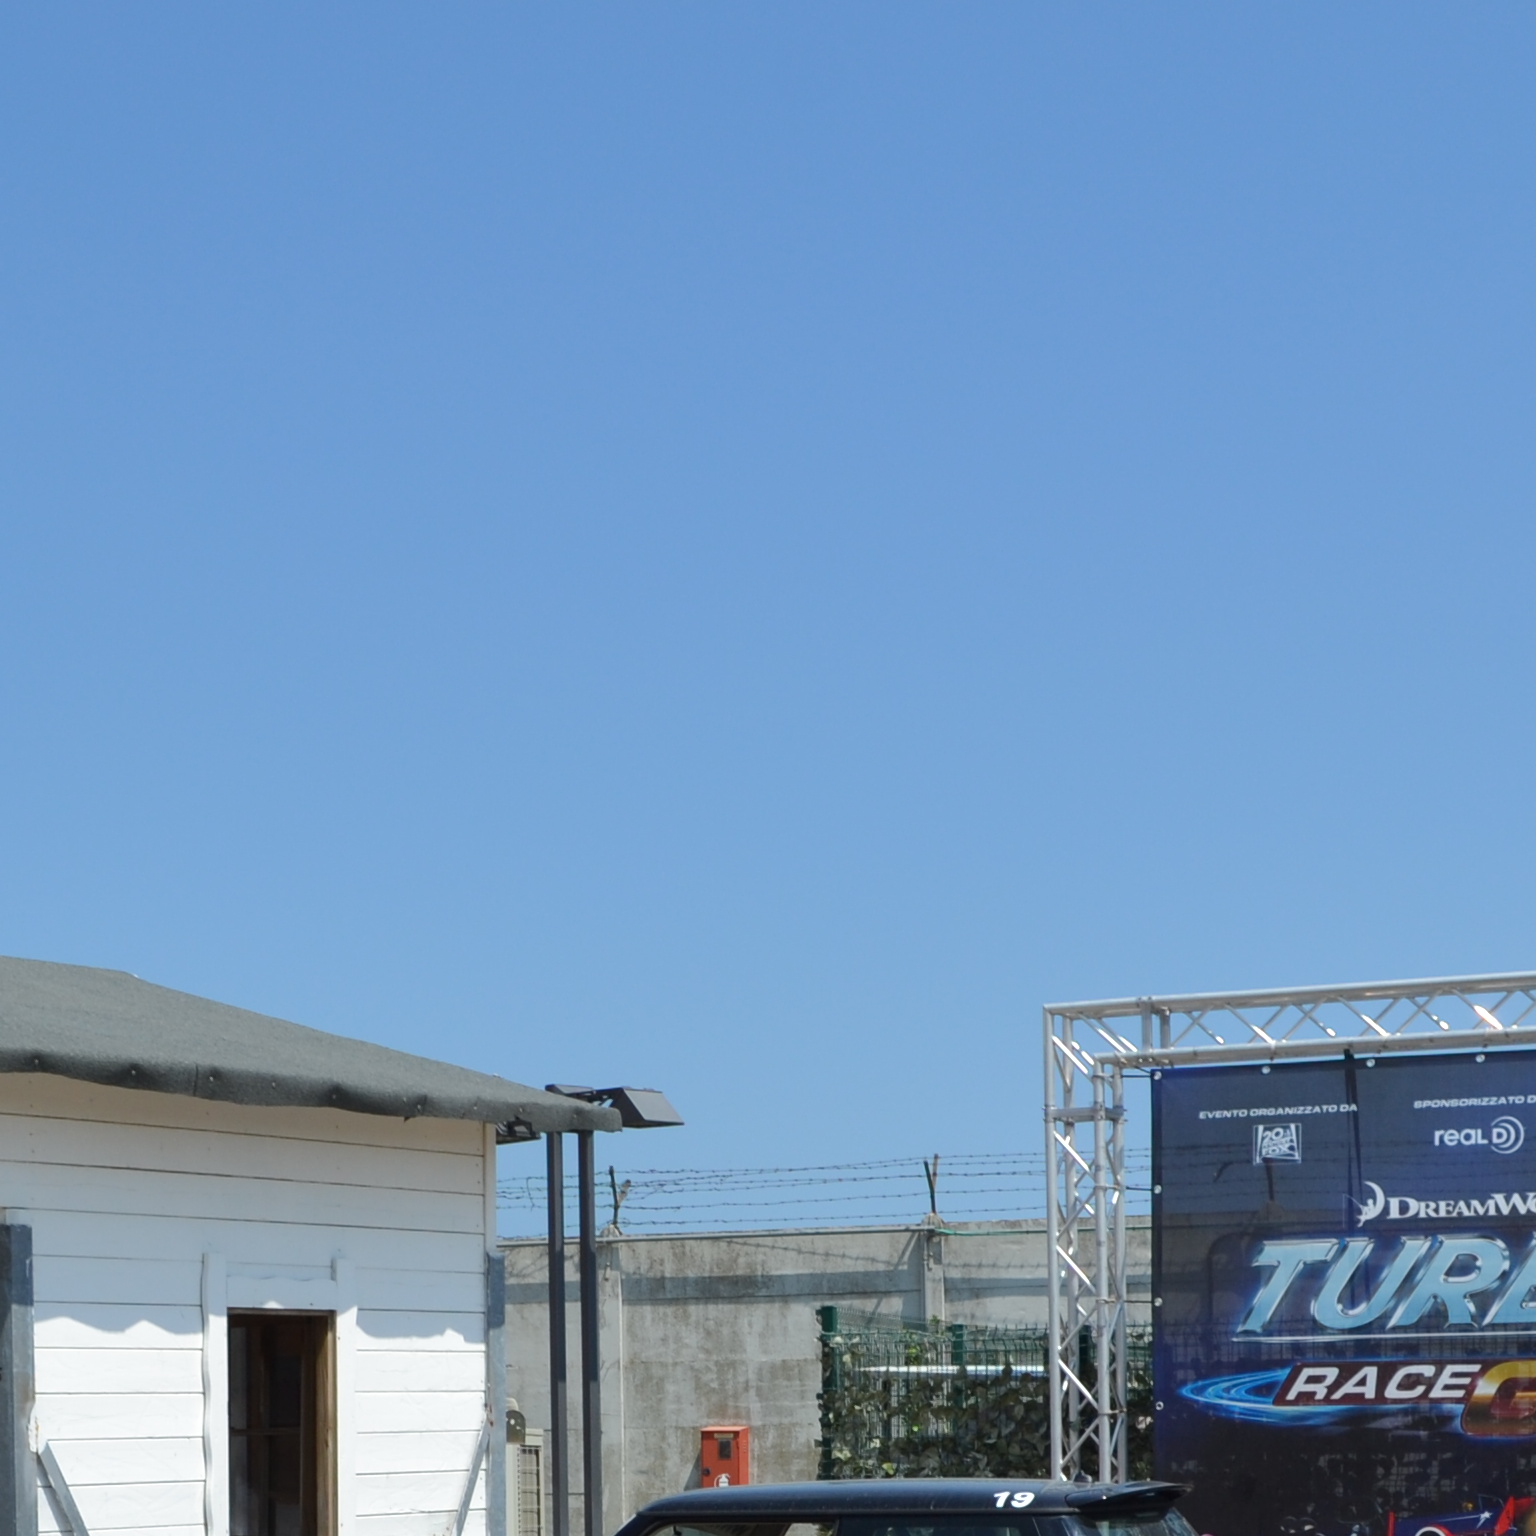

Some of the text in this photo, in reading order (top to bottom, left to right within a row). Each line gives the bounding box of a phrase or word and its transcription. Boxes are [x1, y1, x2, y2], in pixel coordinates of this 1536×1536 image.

[1414, 1096, 1523, 1109] SPONSORIZZATO
[1199, 1103, 1358, 1119] EVENTO ORGANIZZATO DA
[1283, 1362, 1480, 1403] RACE
[994, 1491, 1035, 1508] 19
